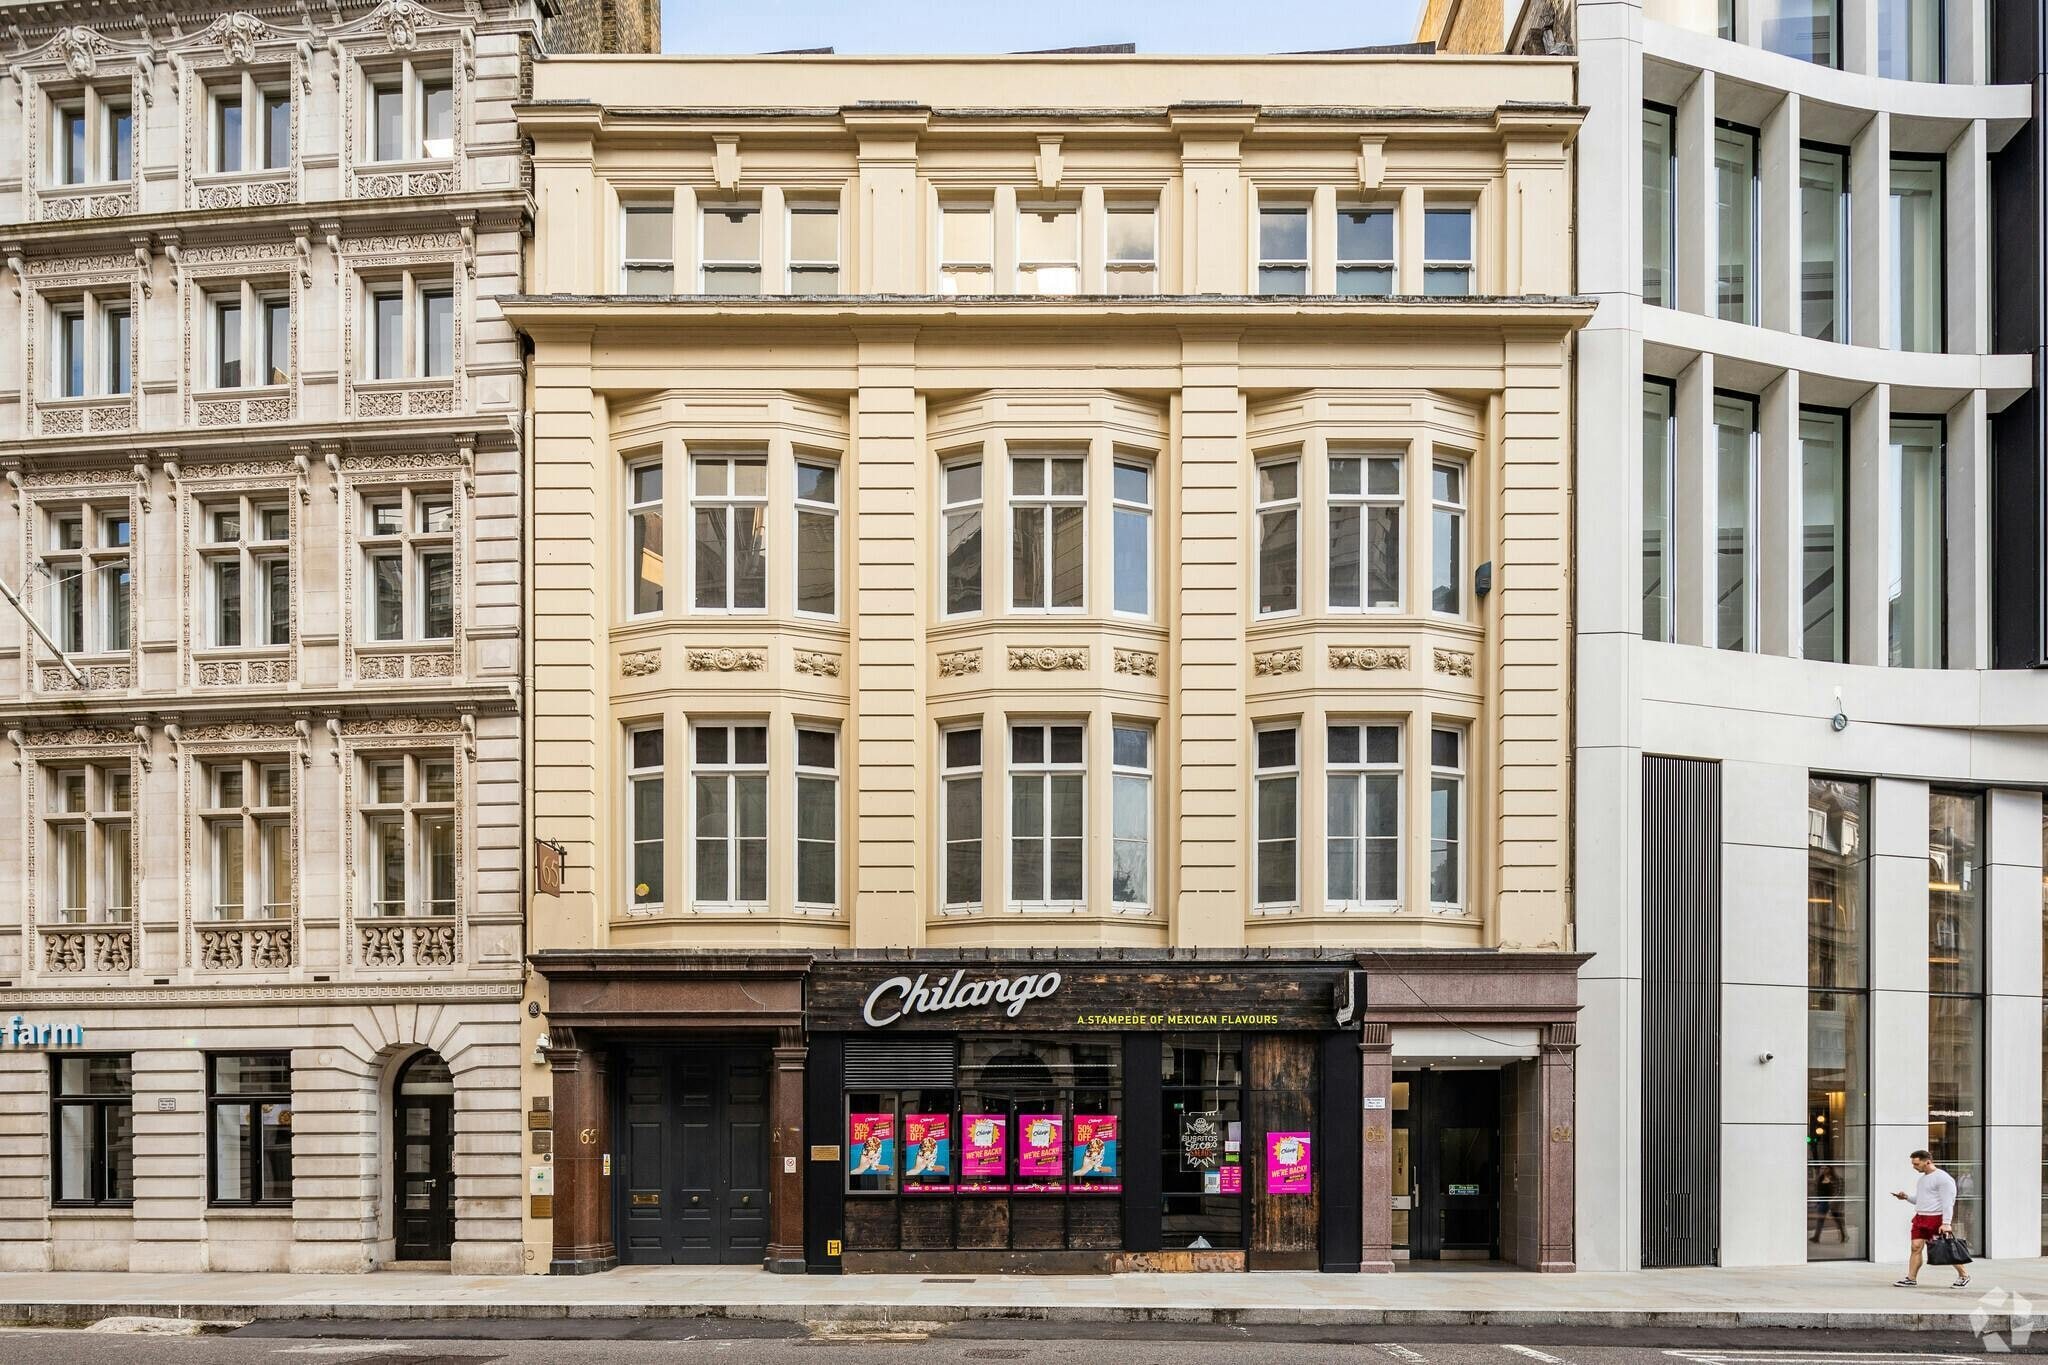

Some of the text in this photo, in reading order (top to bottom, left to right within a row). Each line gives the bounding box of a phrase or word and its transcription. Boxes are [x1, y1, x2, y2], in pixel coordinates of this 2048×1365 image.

[542, 855, 559, 887] 65
[863, 969, 1062, 1027] Chilango
[1077, 1015, 1278, 1025] A STAMPEDE OF MEXICAN FLAVOURS
[854, 1123, 869, 1132] 50%
[910, 1124, 925, 1133] 50%
[1078, 1125, 1093, 1134] 50%
[580, 1128, 597, 1144] 65
[854, 1132, 868, 1140] OFF
[910, 1133, 924, 1141] OFF
[1078, 1134, 1092, 1142] OFF
[829, 1241, 840, 1254] H
